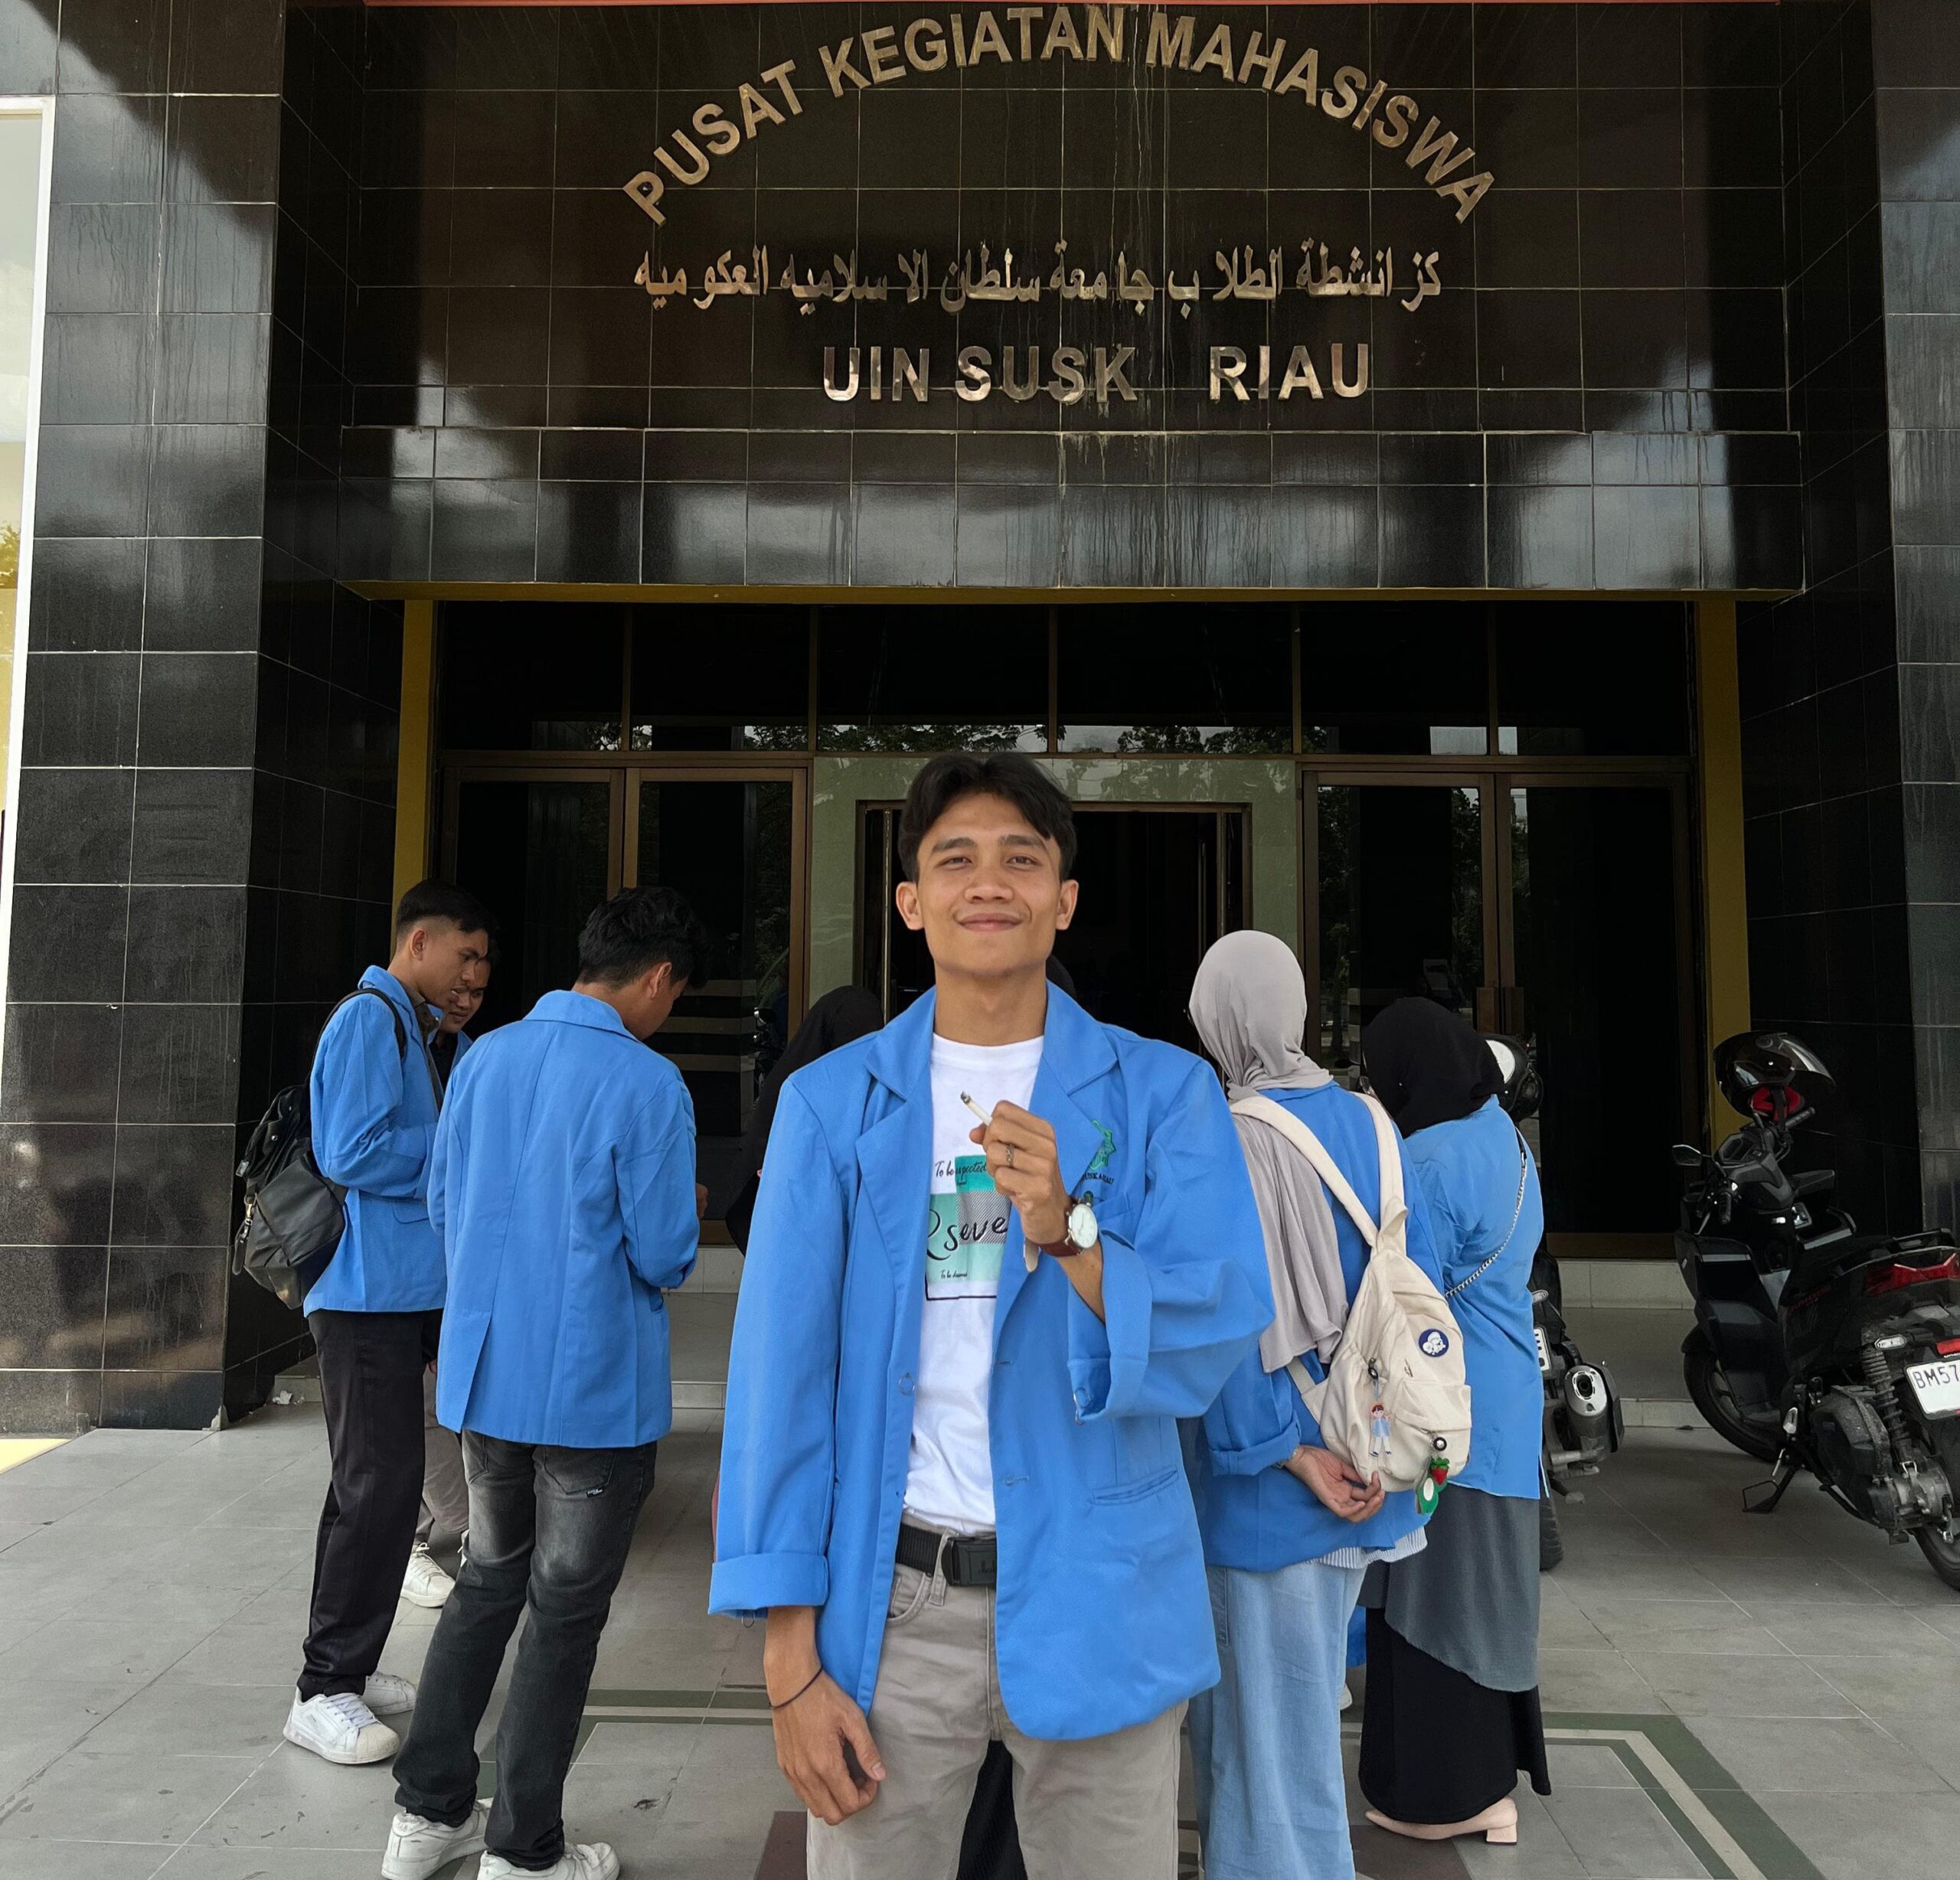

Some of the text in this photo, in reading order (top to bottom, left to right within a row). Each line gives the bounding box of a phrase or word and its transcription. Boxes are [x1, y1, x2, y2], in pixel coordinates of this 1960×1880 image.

[622, 6, 1495, 227] PUSAT KEGIATAN MAHASISWA
[823, 343, 1369, 404] UIN SUSK RIAU
